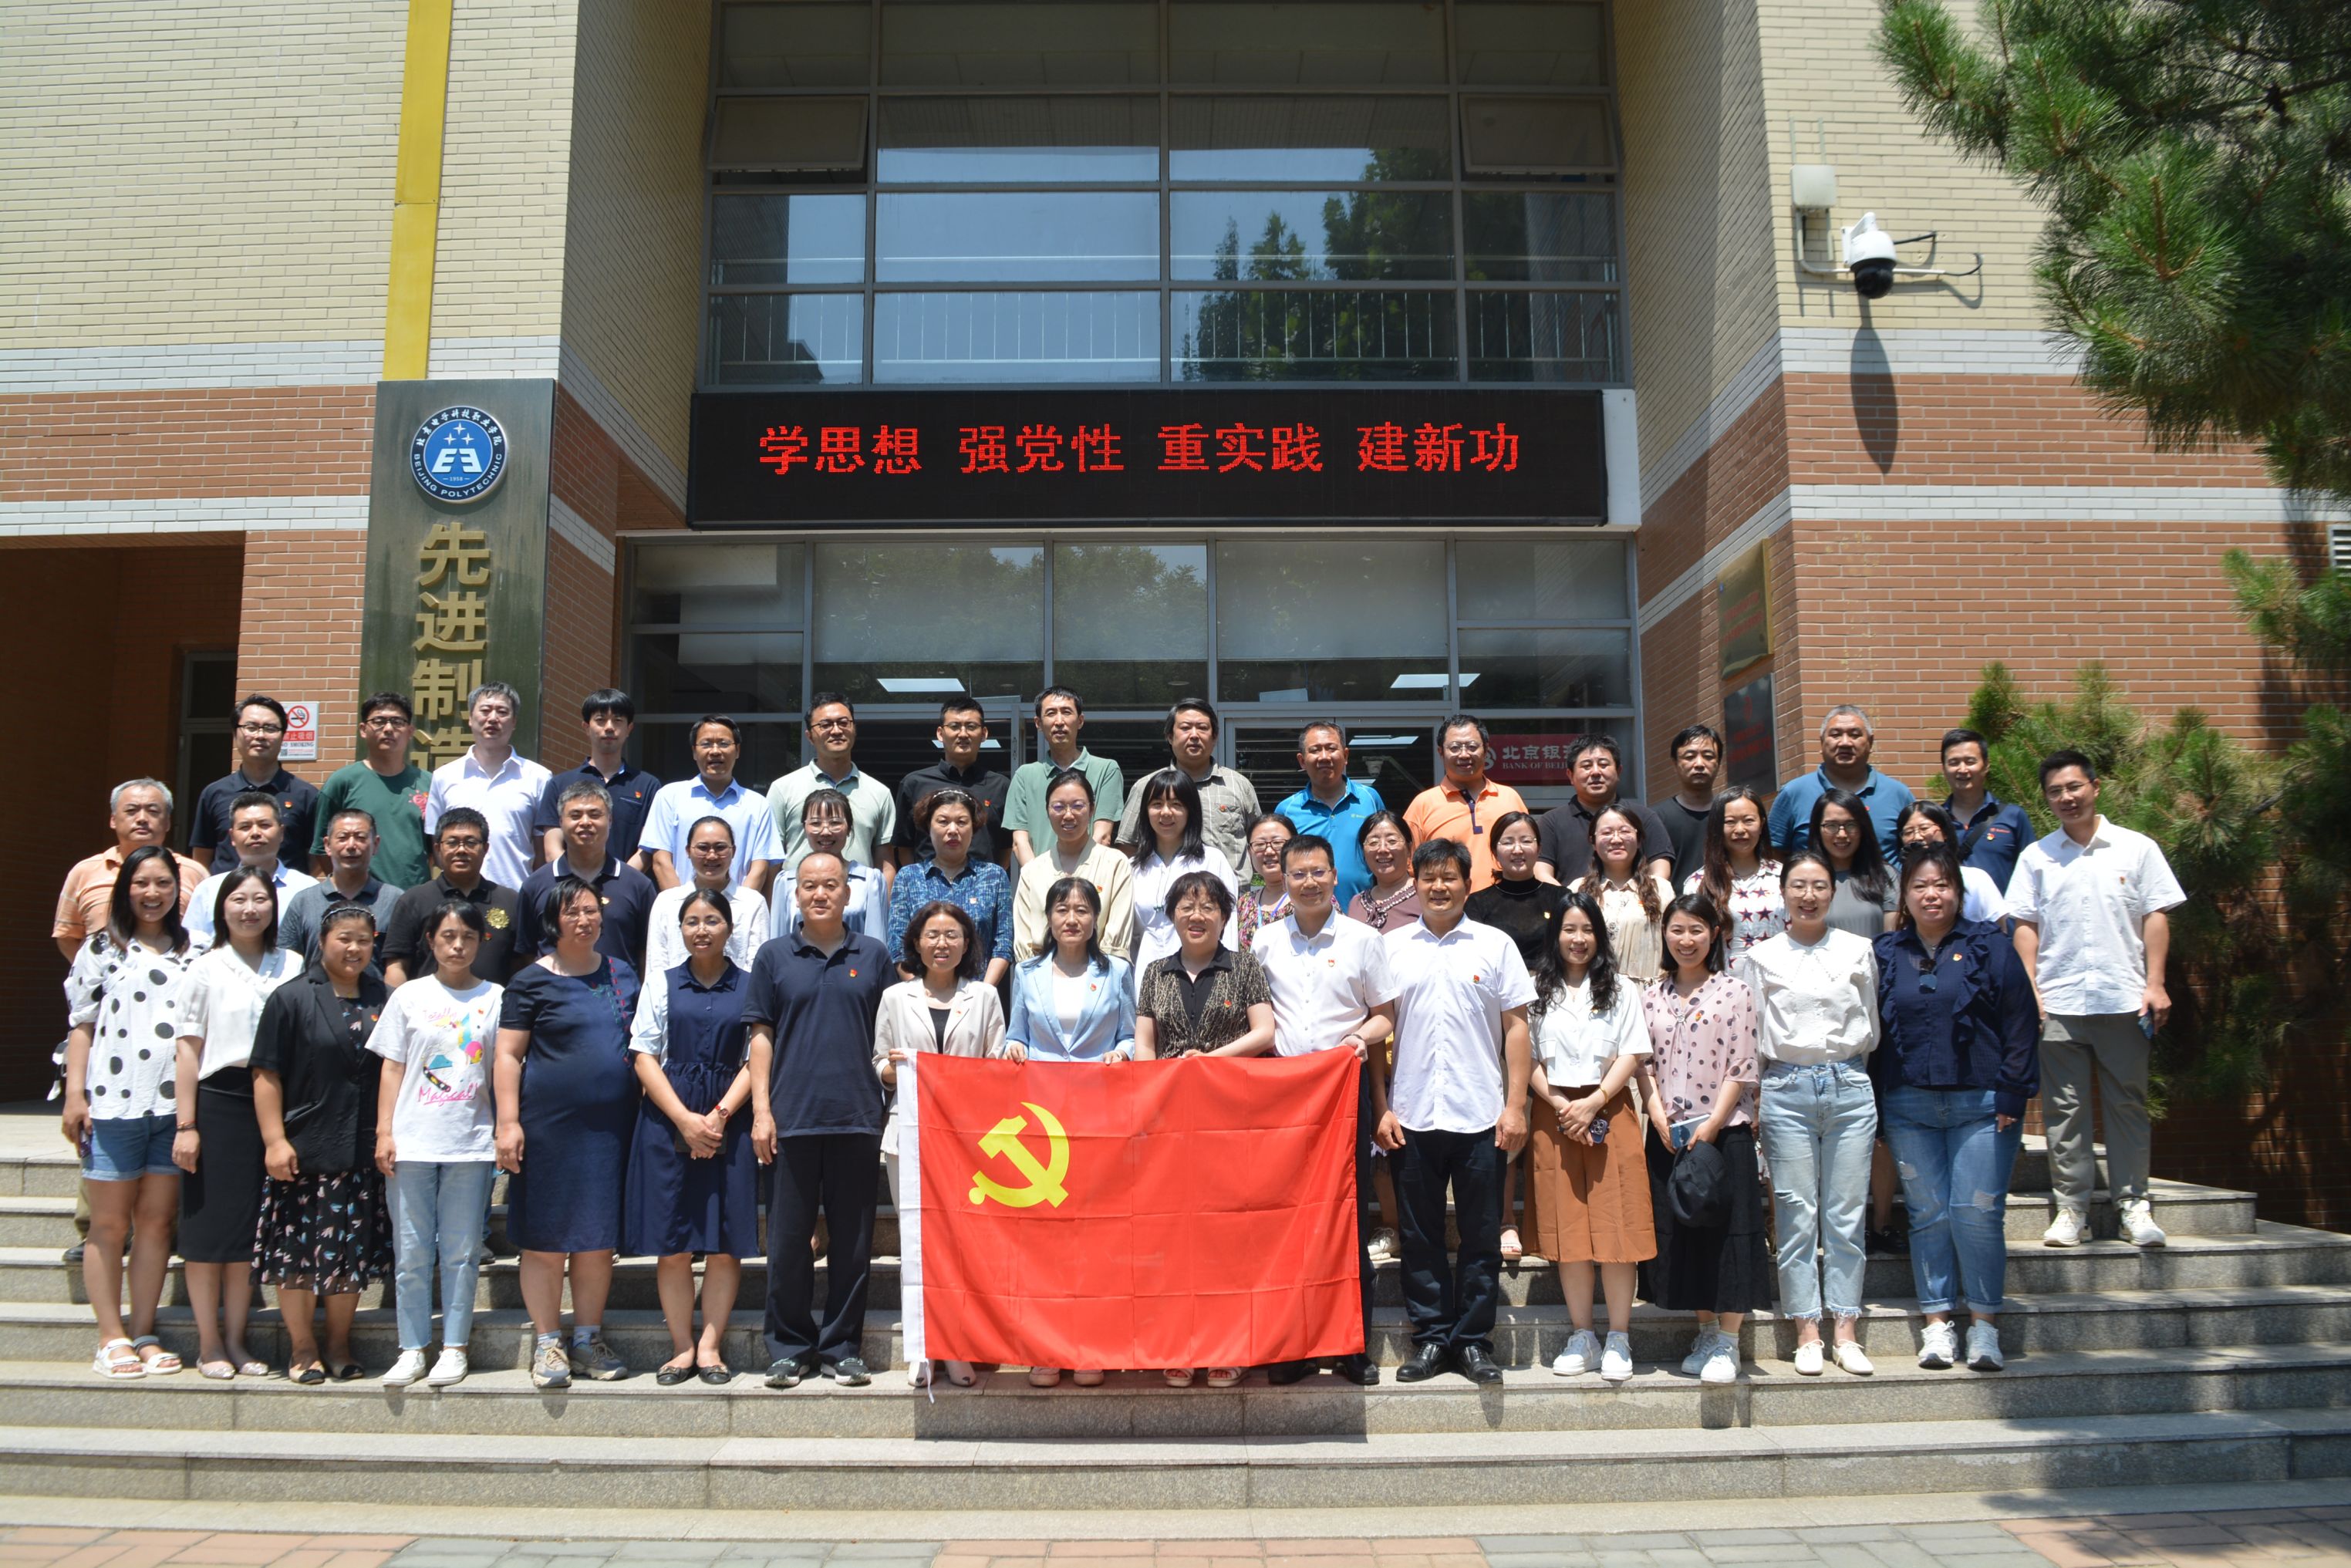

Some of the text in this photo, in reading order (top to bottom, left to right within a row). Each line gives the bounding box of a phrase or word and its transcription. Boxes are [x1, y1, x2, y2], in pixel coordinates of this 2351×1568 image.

[416, 408, 502, 447] 北京电子科技职业学院
[760, 421, 1519, 474] 学思想 强党性 重实践 建新功
[413, 453, 502, 497] BEIJING POLYTECHNIC
